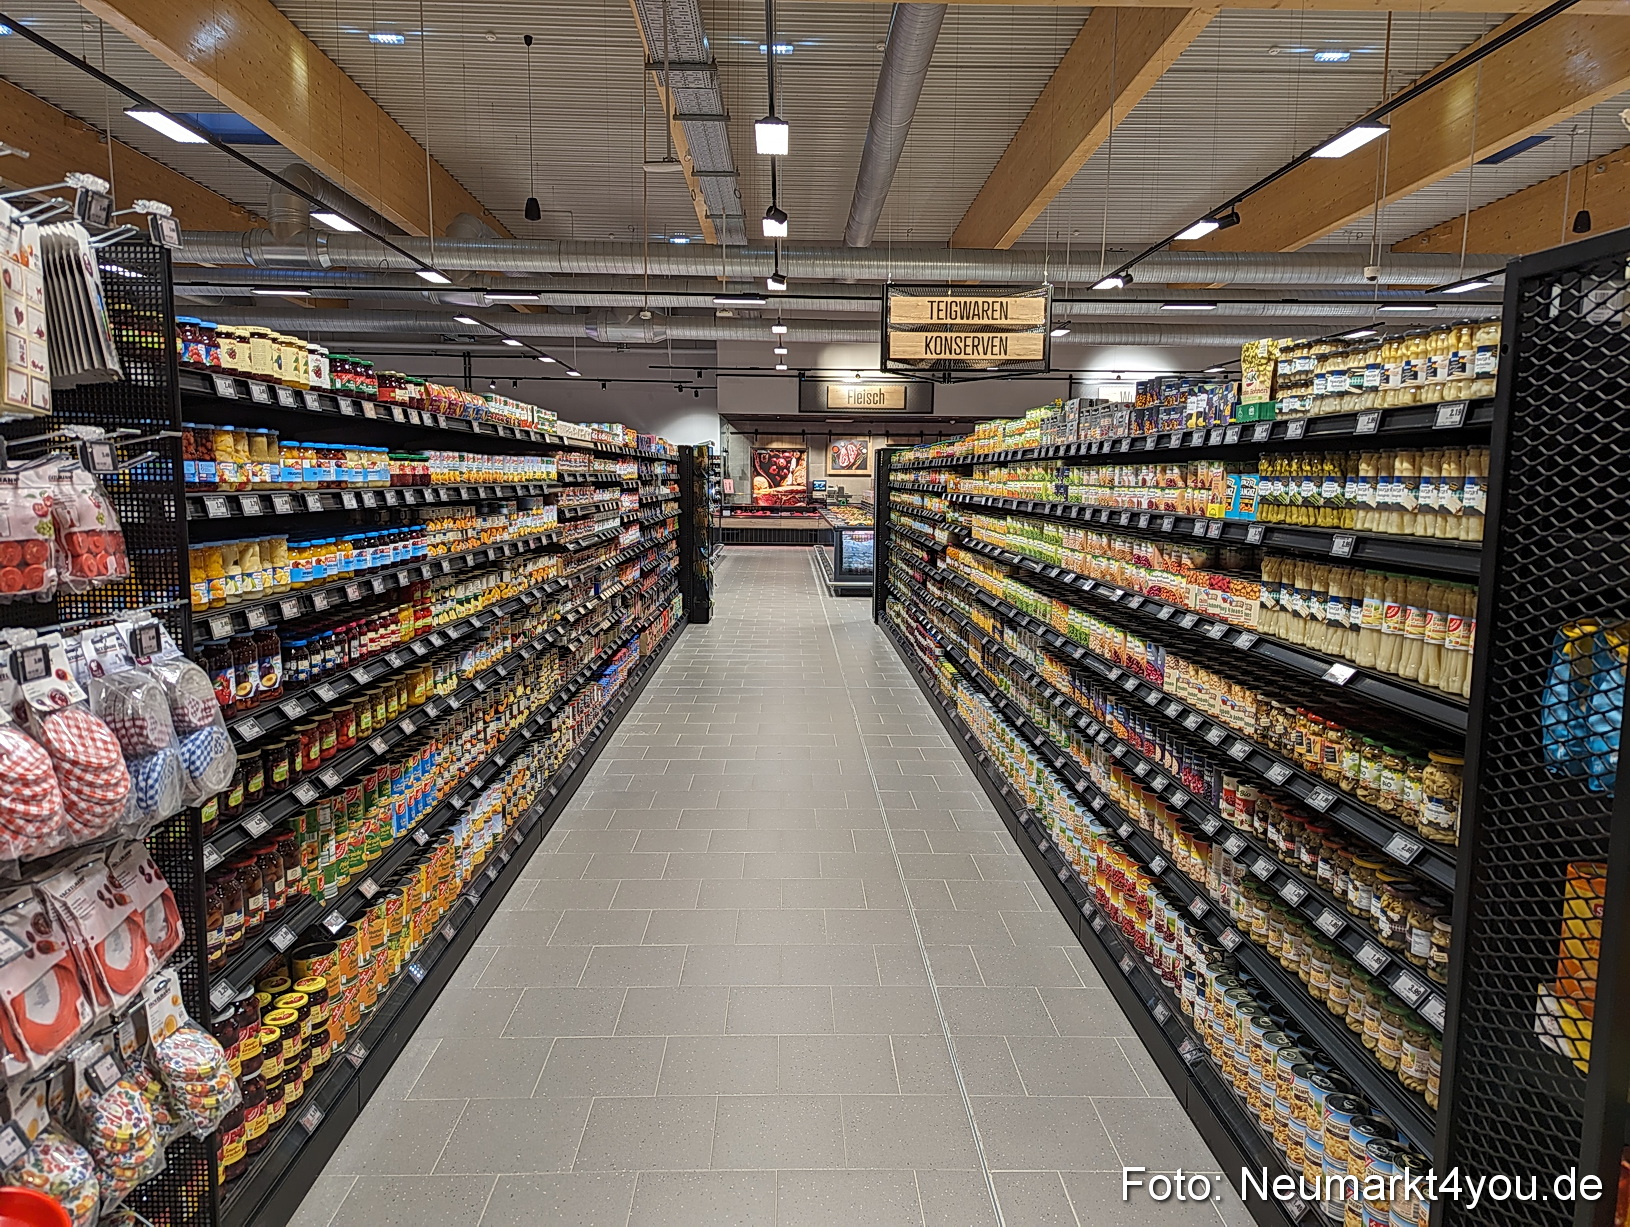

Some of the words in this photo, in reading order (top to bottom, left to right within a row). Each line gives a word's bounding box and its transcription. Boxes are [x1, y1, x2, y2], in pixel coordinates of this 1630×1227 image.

[927, 300, 1008, 321] TEIGWAREN
[924, 335, 1008, 356] KONSERVEN
[847, 388, 885, 405] Fleisch
